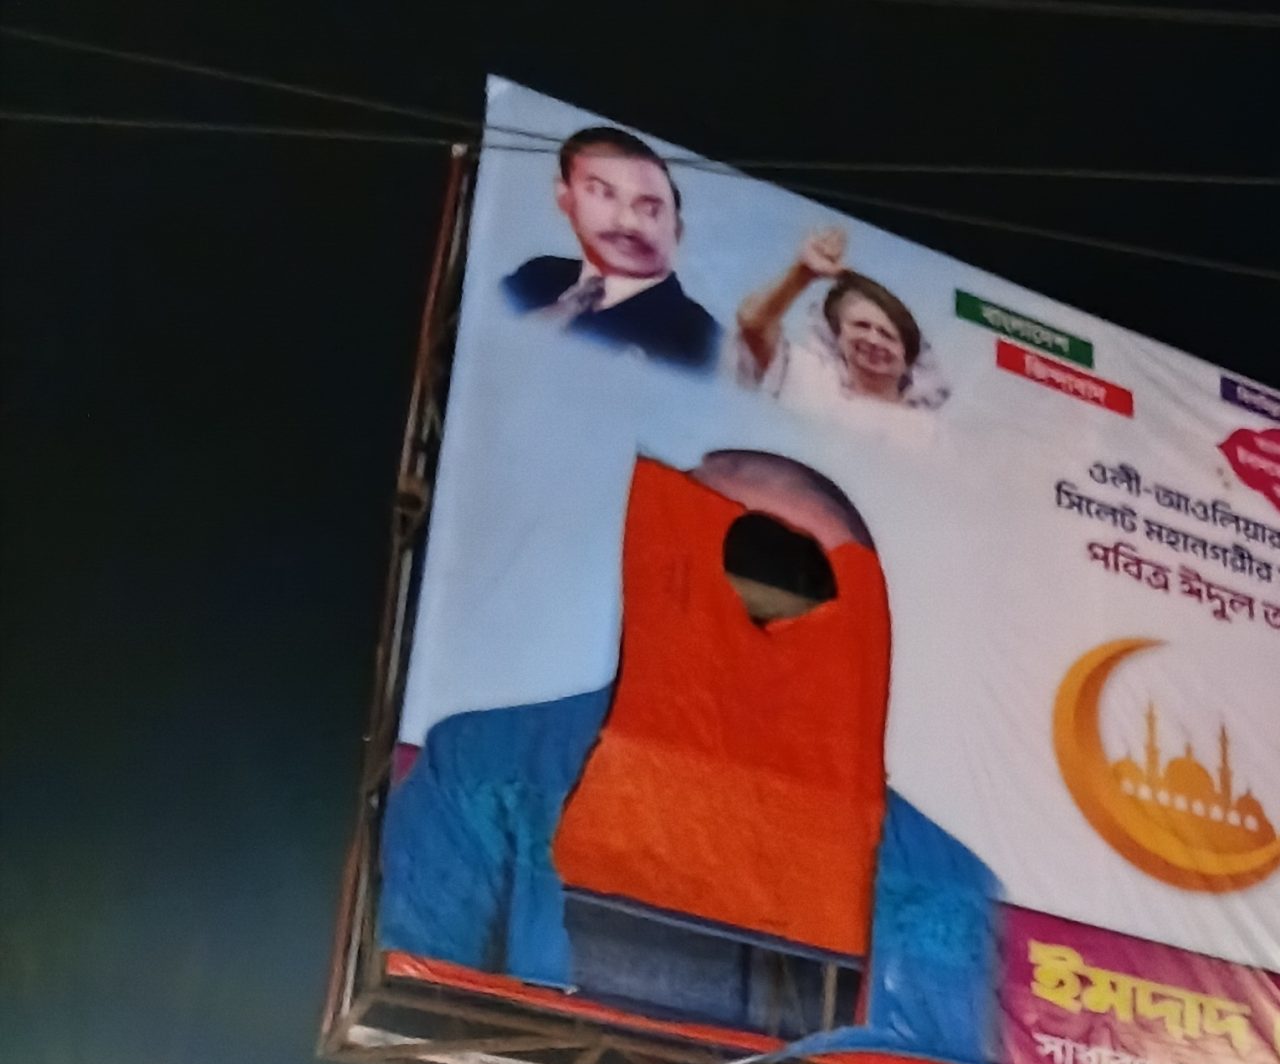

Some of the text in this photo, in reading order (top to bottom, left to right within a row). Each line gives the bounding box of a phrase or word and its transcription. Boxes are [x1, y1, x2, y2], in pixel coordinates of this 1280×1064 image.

[1055, 480, 1137, 534] সিলেট
[1143, 517, 1272, 583] মহানগরীর
[1087, 541, 1173, 593] পবিত্র
[1178, 564, 1255, 623] ঈদুল
[1026, 937, 1257, 1061] ইমদাদ
